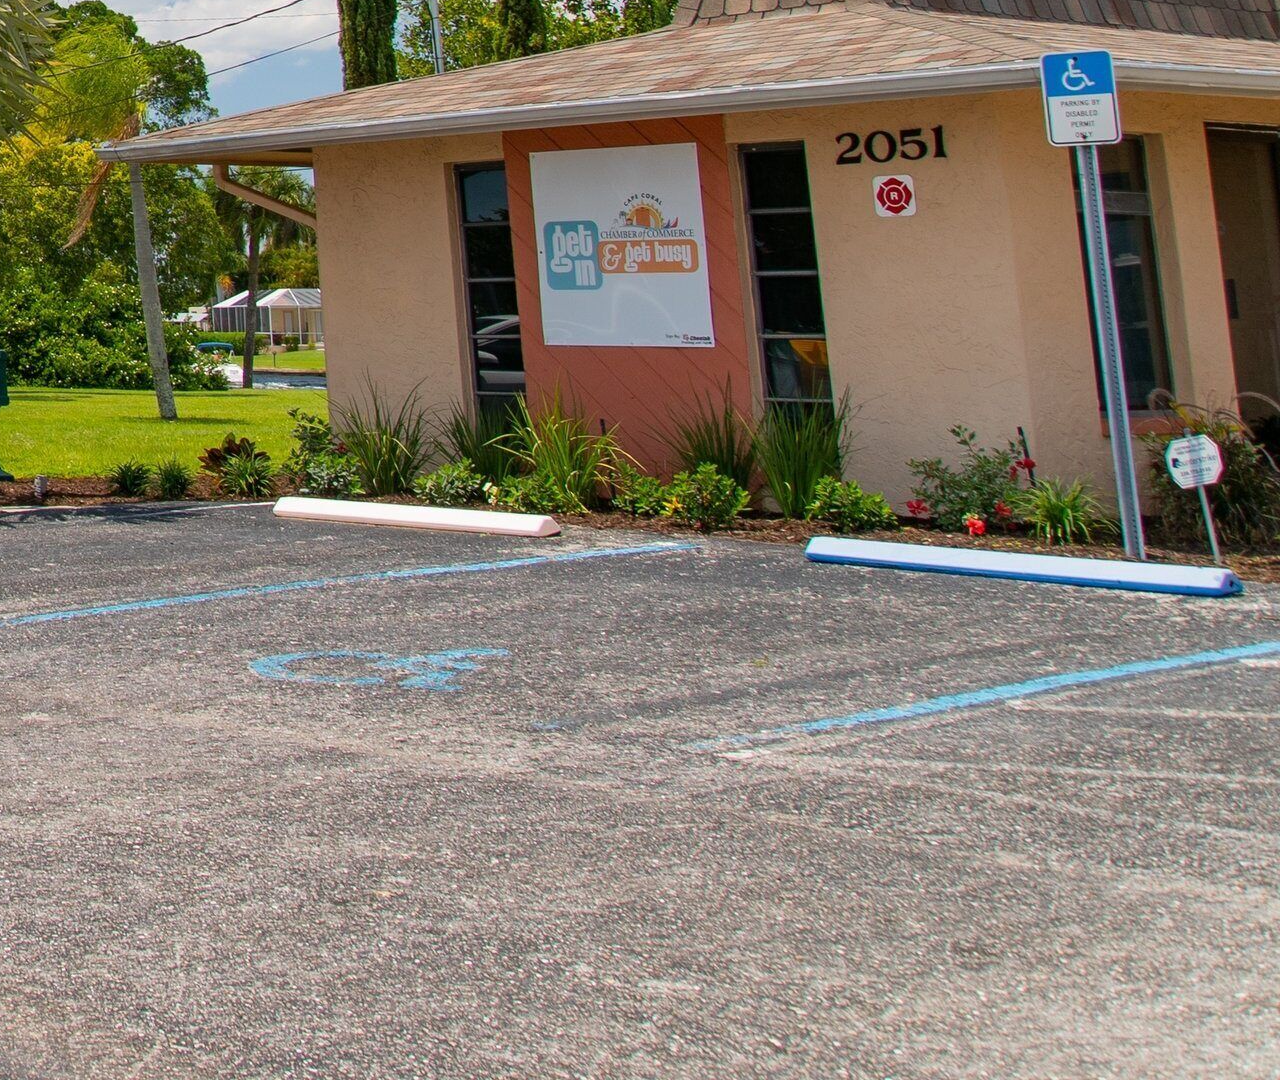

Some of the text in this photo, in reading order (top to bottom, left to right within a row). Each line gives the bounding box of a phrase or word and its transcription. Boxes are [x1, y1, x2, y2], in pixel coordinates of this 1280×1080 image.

[1060, 99, 1089, 107] PARKING
[1065, 109, 1098, 118] DISABLED
[1070, 120, 1095, 128] PERMIT
[835, 124, 947, 165] 2051
[624, 192, 662, 207] CAPE CORAL
[890, 191, 898, 200] R
[600, 229, 638, 239] CHAMBER
[646, 228, 694, 239] COMMERCE
[550, 224, 593, 273] get
[624, 241, 651, 272] get
[654, 241, 692, 269] busy
